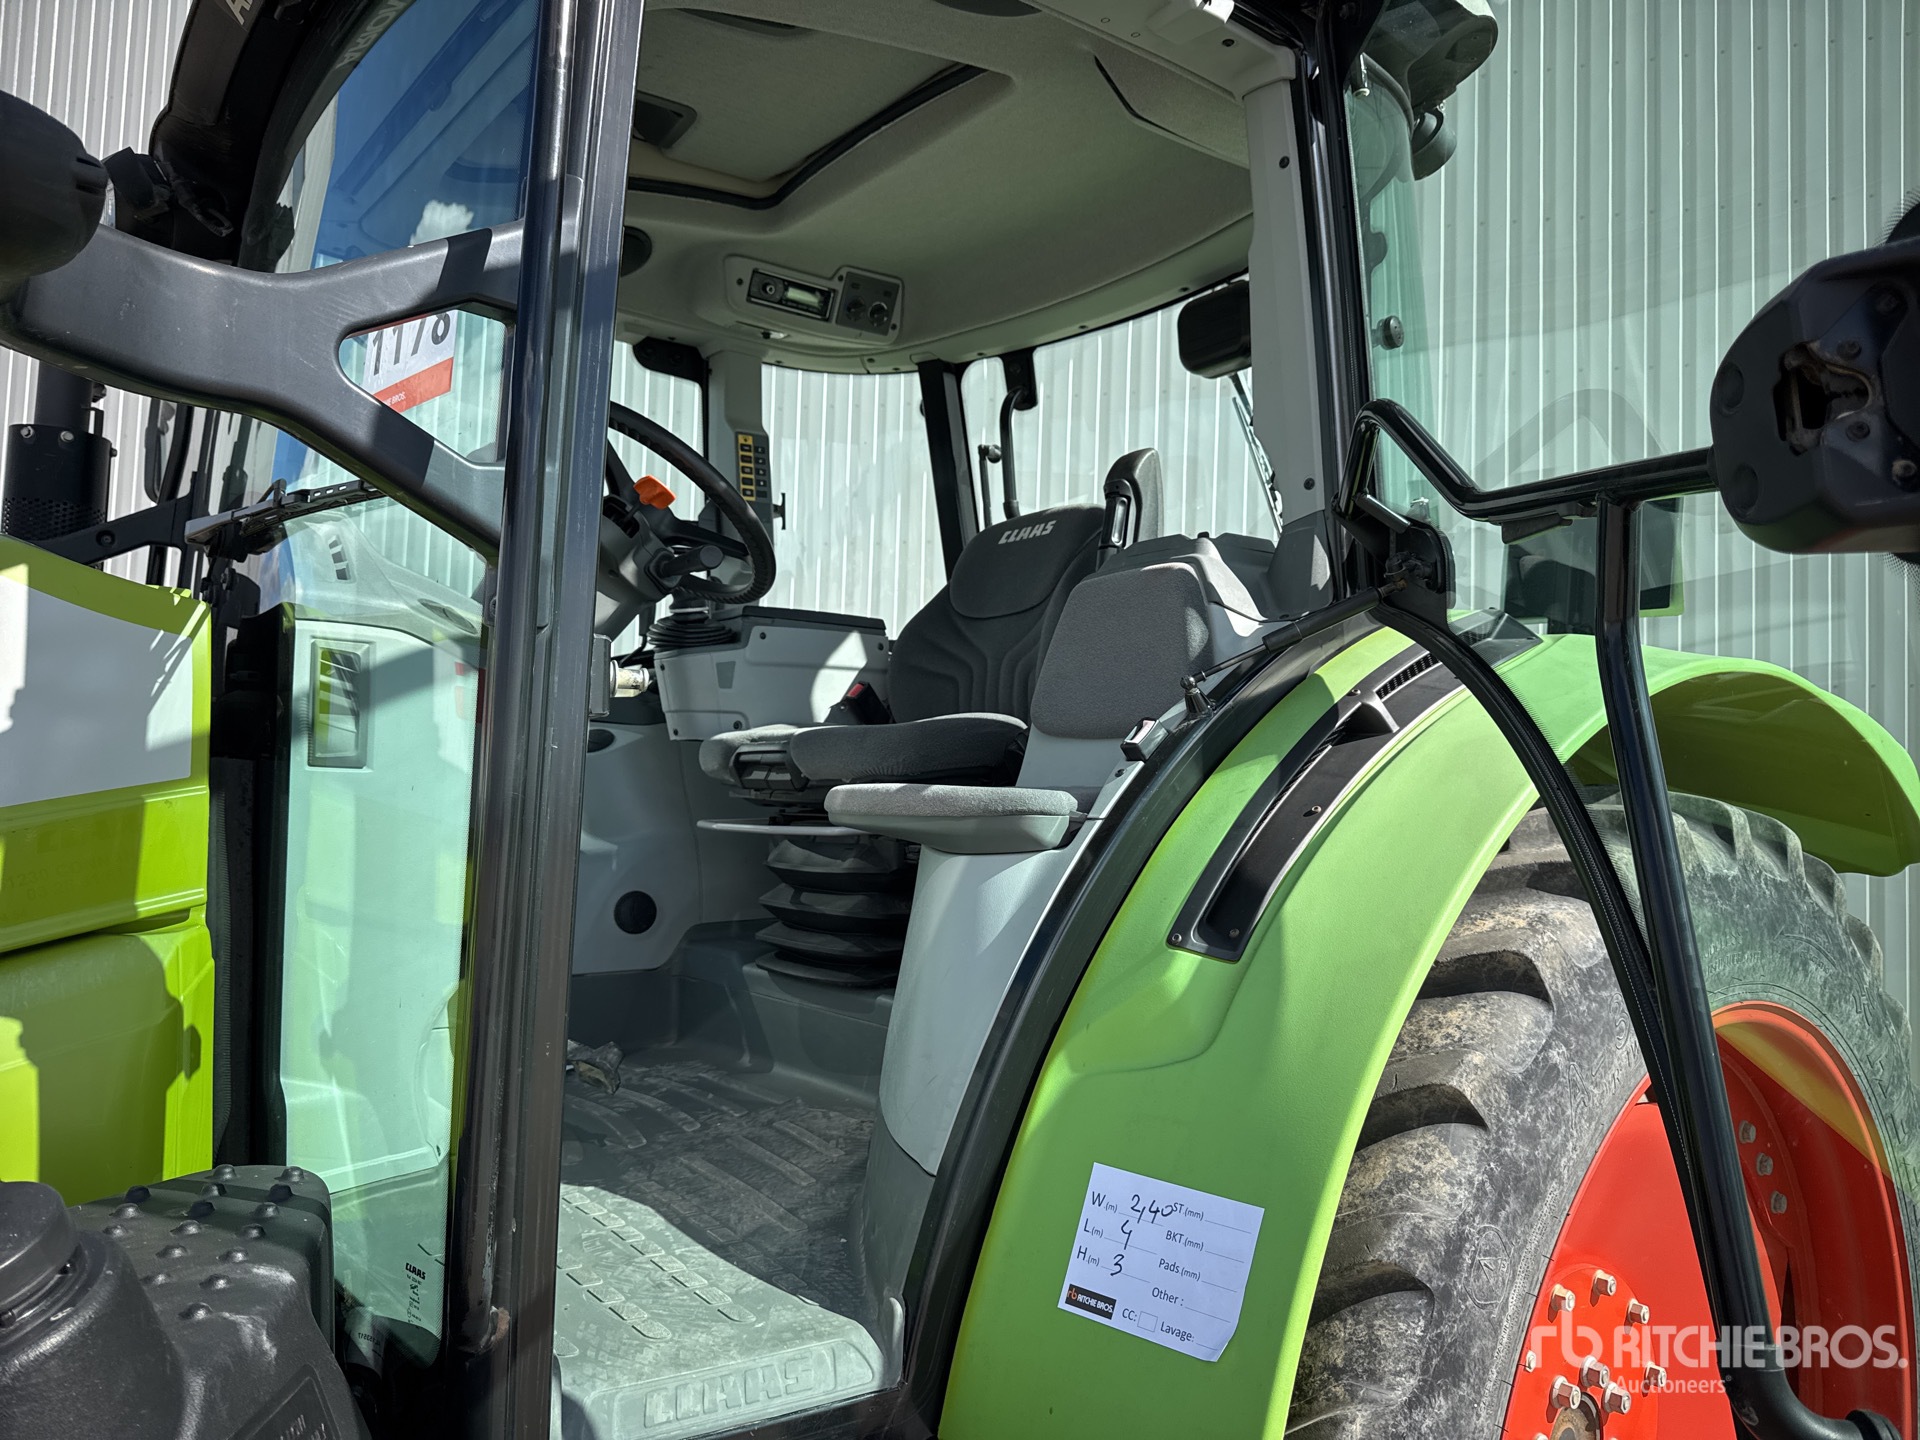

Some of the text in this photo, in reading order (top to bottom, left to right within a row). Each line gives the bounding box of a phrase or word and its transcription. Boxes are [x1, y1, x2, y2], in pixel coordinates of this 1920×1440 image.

[998, 520, 1057, 545] CLAAS
[1120, 1219, 1133, 1250] 4
[405, 1262, 426, 1280] CLAAS
[1110, 1253, 1125, 1277] 3
[1077, 1294, 1098, 1308] RITCHIE
[1122, 1308, 1195, 1343] CC: Lavage:
